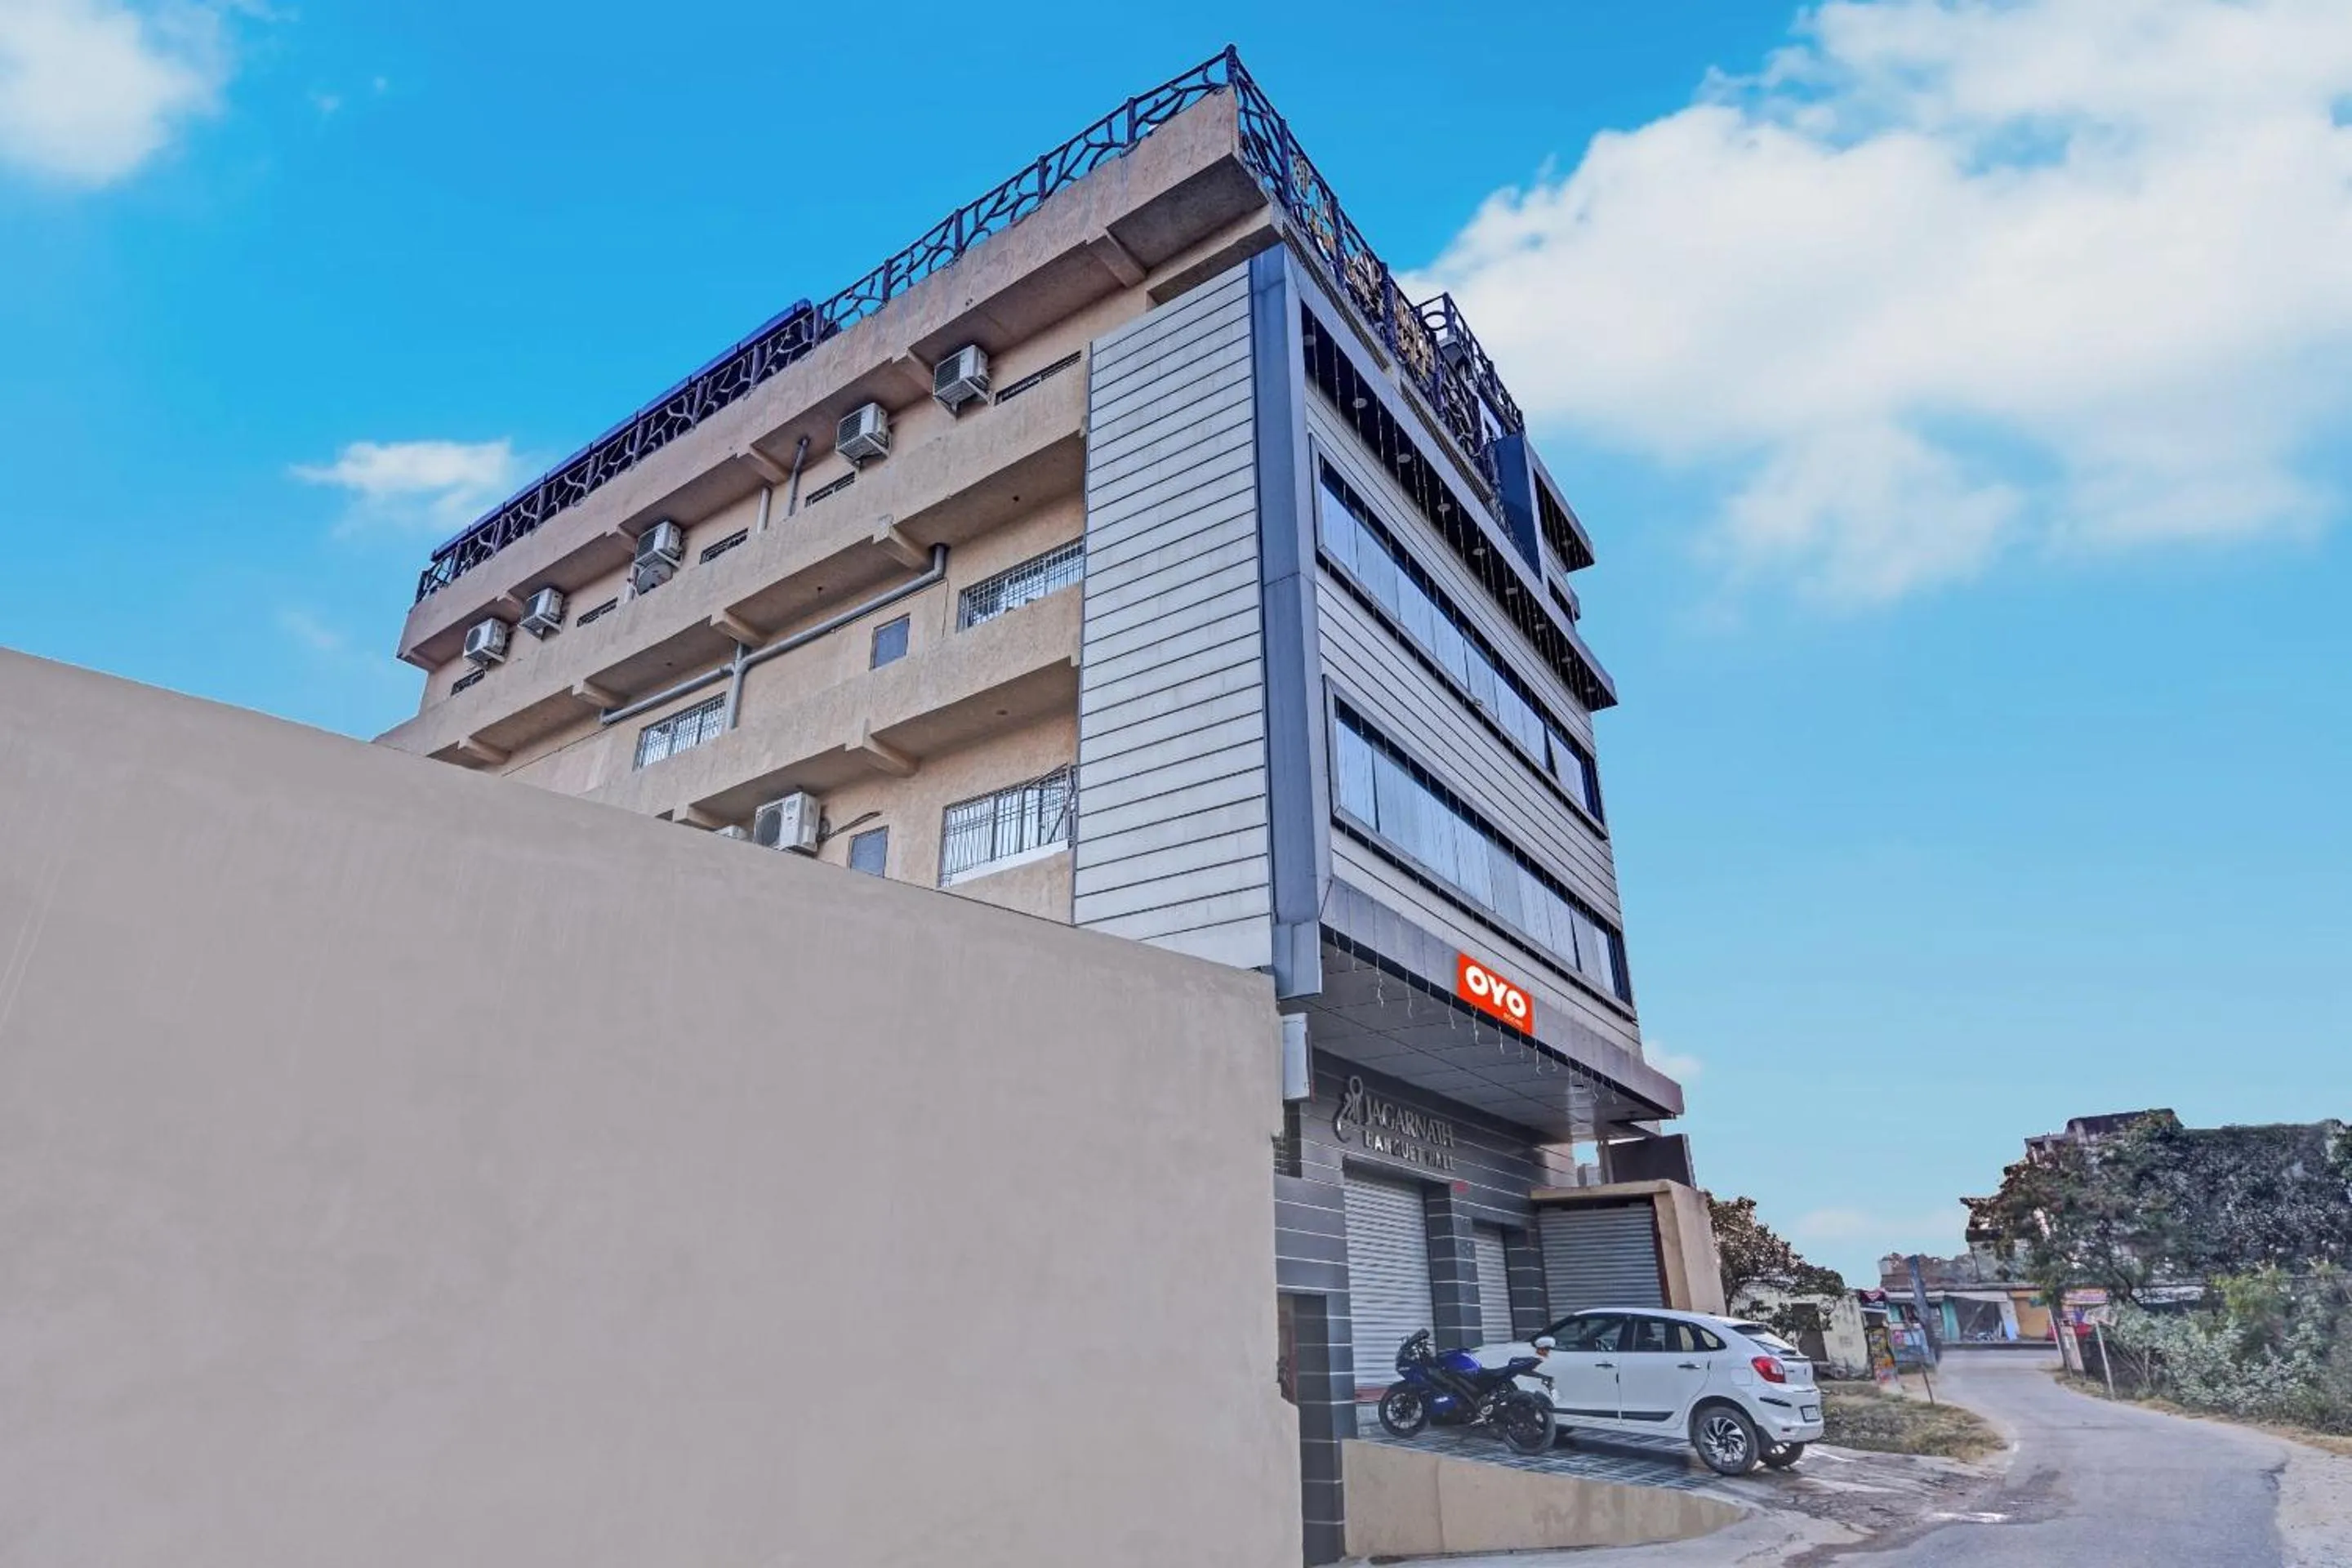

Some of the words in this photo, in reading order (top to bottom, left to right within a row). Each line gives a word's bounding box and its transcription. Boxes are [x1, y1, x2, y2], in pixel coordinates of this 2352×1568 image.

[1465, 964, 1526, 1018] OYO
[1365, 1094, 1455, 1147] JAGARNATH
[1364, 1129, 1427, 1168] BANQUET
[1428, 1150, 1456, 1171] HALL
